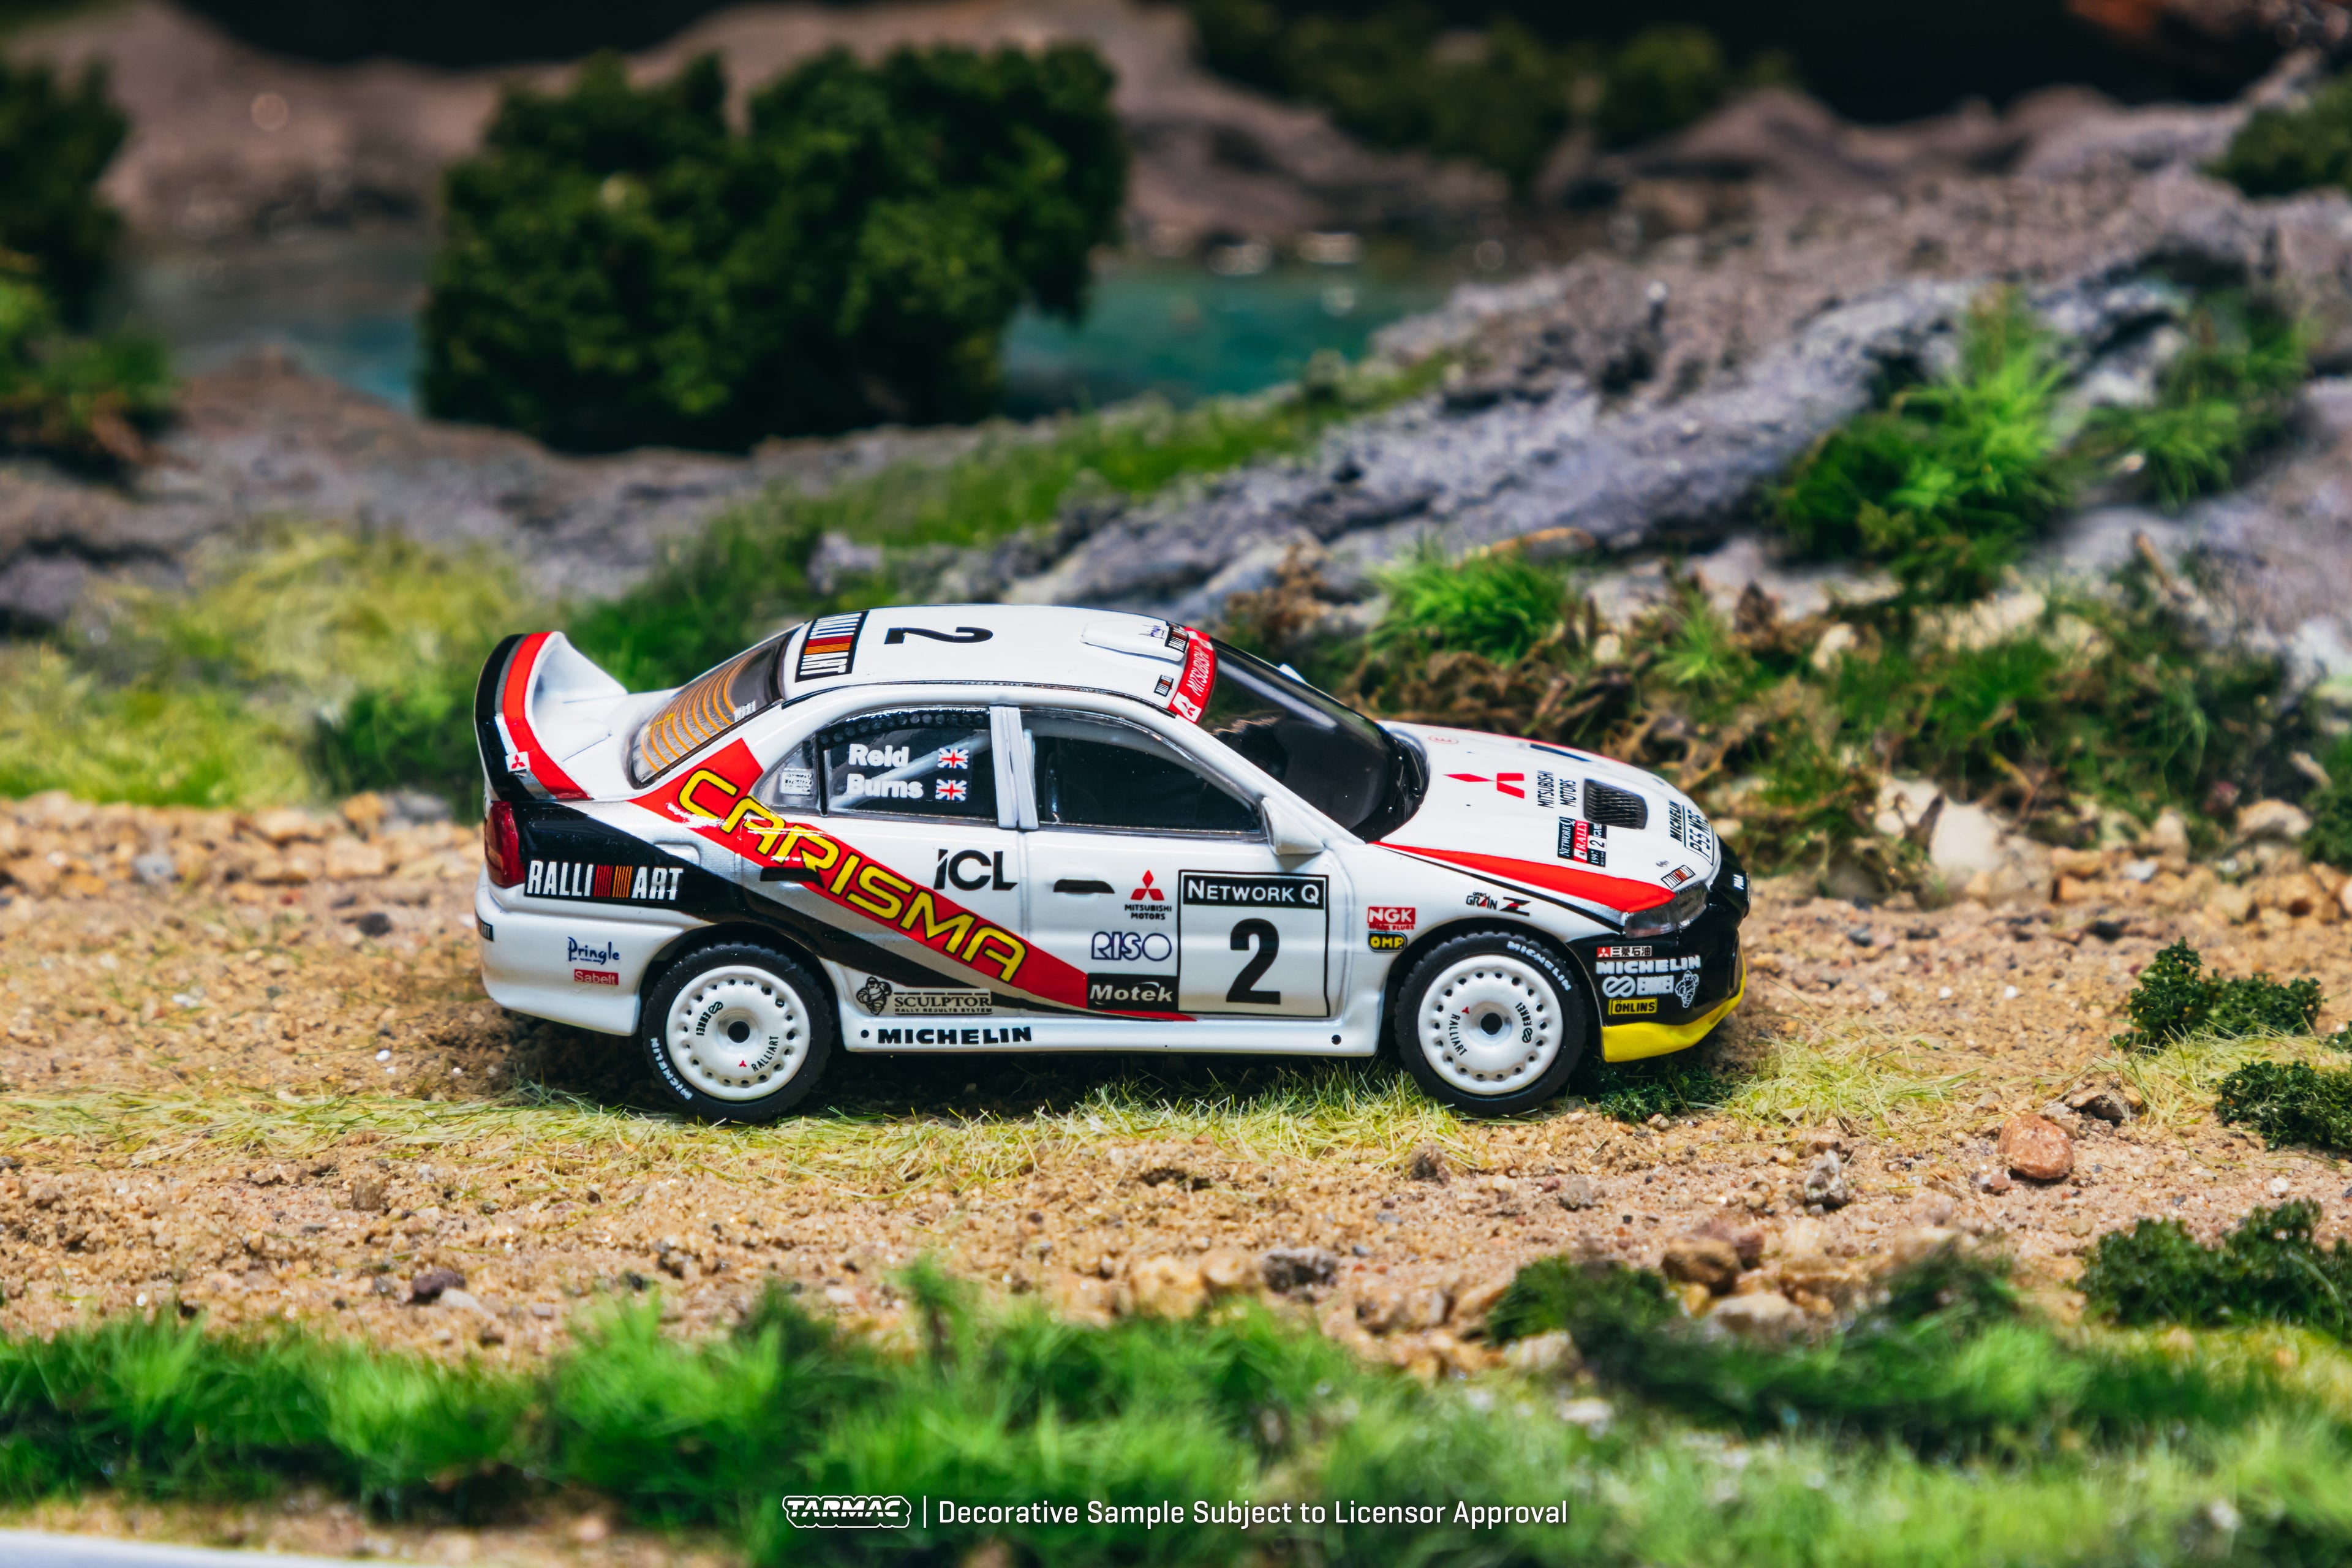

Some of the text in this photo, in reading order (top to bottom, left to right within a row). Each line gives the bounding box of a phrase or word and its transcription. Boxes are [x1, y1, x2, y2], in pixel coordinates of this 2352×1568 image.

[884, 627, 993, 644] 2
[1186, 645, 1210, 697] MITSUBISHI
[848, 743, 910, 767] Reid
[846, 774, 924, 798] Burns
[1537, 770, 1554, 809] MITSUBISHI
[1559, 778, 1576, 807] MOTORS
[1668, 799, 1683, 842] MICHELIN
[1559, 818, 1576, 857] NETWORK Q
[1576, 821, 1588, 850] RALLY
[1689, 829, 1710, 859] P55
[527, 860, 684, 900] RALLI ART
[679, 768, 1028, 984] CARISMA
[1188, 880, 1320, 905] NETWORK Q
[1368, 908, 1412, 923] NGK
[568, 936, 620, 965] Pringle
[1091, 932, 1172, 962] RISO
[1370, 936, 1404, 949] OMP
[1611, 946, 1652, 957] 三菱石油
[1226, 918, 1281, 1005] 2
[1596, 955, 1701, 974] MICHELIN
[575, 971, 616, 985] Sabelt
[894, 997, 992, 1007] SCULPTOR
[1090, 982, 1173, 1005] Motek
[1615, 1000, 1656, 1013] ÖHLINS
[877, 1027, 1032, 1045] MICHELIN
[1449, 1014, 1468, 1056] RALLIART
[751, 1036, 779, 1072] RALLIART
